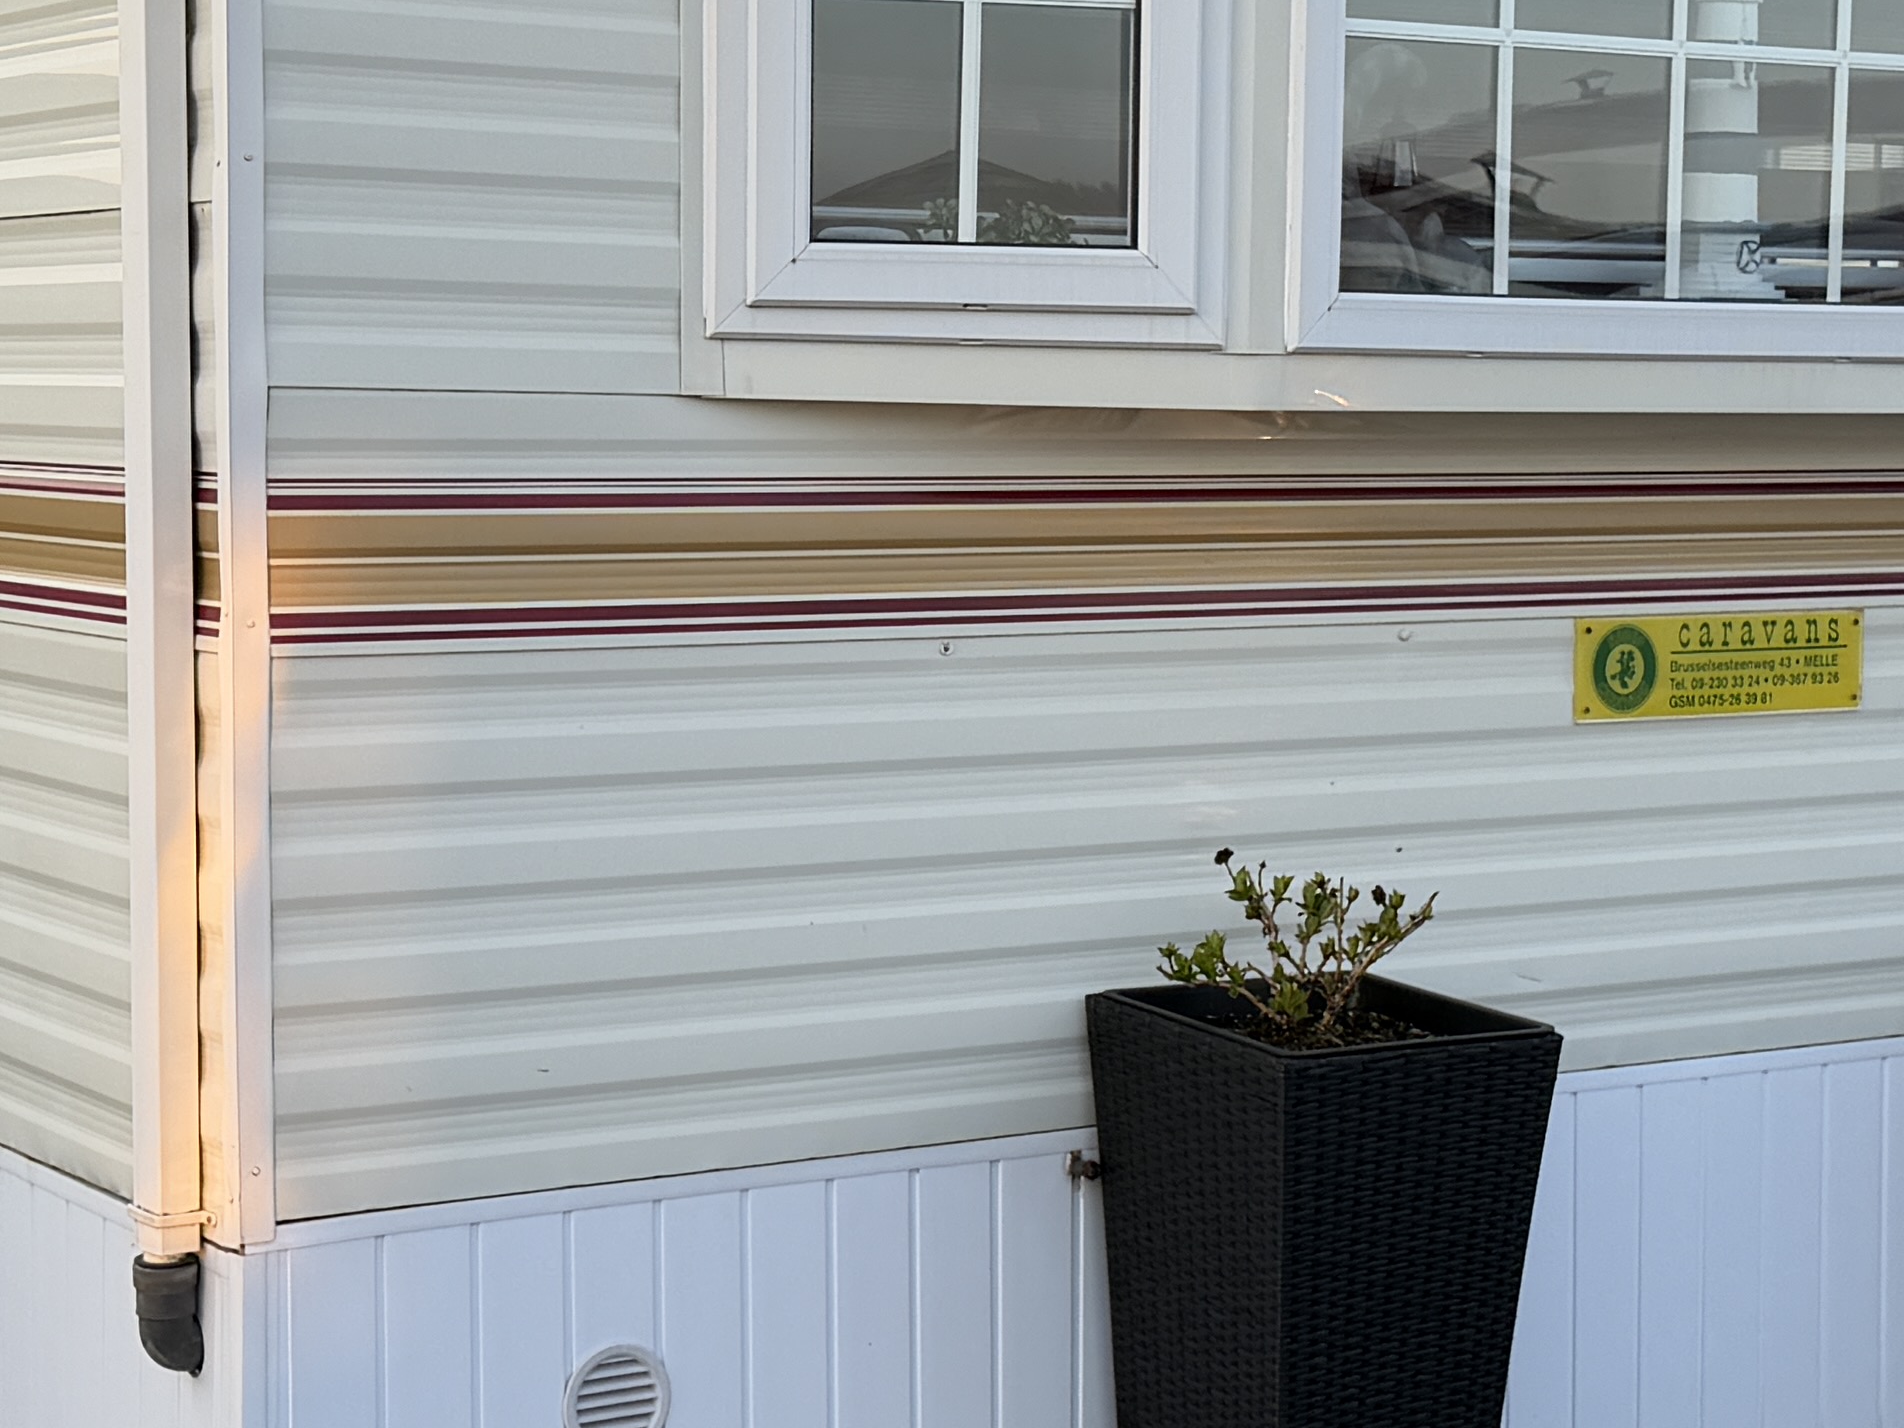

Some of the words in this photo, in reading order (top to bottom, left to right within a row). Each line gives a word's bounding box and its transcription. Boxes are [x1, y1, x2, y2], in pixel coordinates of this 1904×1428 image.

[1678, 617, 1840, 648] caravans
[1804, 654, 1838, 667] MELLE
[1669, 677, 1687, 690] Tel.
[1731, 675, 1744, 688] 33
[1747, 674, 1760, 687] 24
[1827, 671, 1840, 684] 26
[1669, 694, 1695, 708] GSM
[1698, 692, 1741, 707] 0475-26
[1760, 691, 1772, 704] 81
